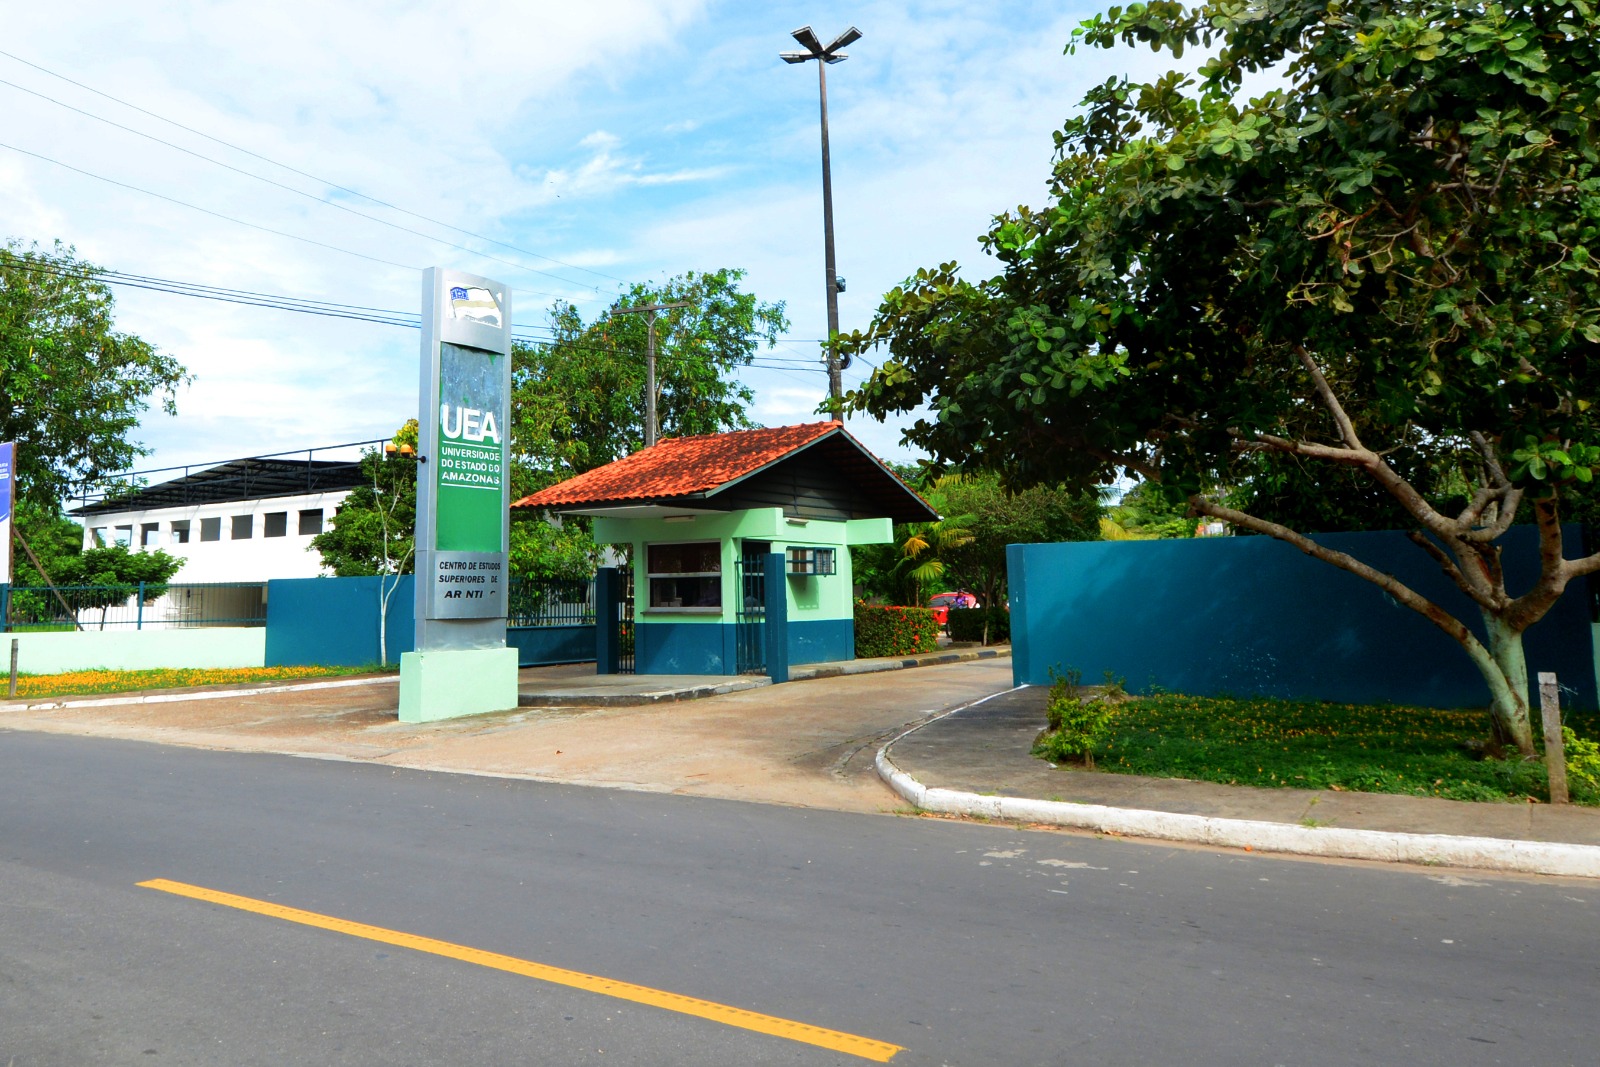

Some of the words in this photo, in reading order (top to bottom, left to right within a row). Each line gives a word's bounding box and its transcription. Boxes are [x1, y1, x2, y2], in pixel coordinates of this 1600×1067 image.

[442, 404, 500, 444] UEA
[441, 446, 500, 461] UNIVERSIDADE
[441, 458, 454, 468] DO
[455, 460, 487, 472] ESTADO
[441, 471, 500, 485] AMAZONAS
[439, 561, 467, 570] CENTRO
[468, 562, 477, 570] DE
[478, 562, 501, 571] ESTUDOS
[438, 574, 486, 584] SUPERIORES
[490, 575, 498, 584] DE
